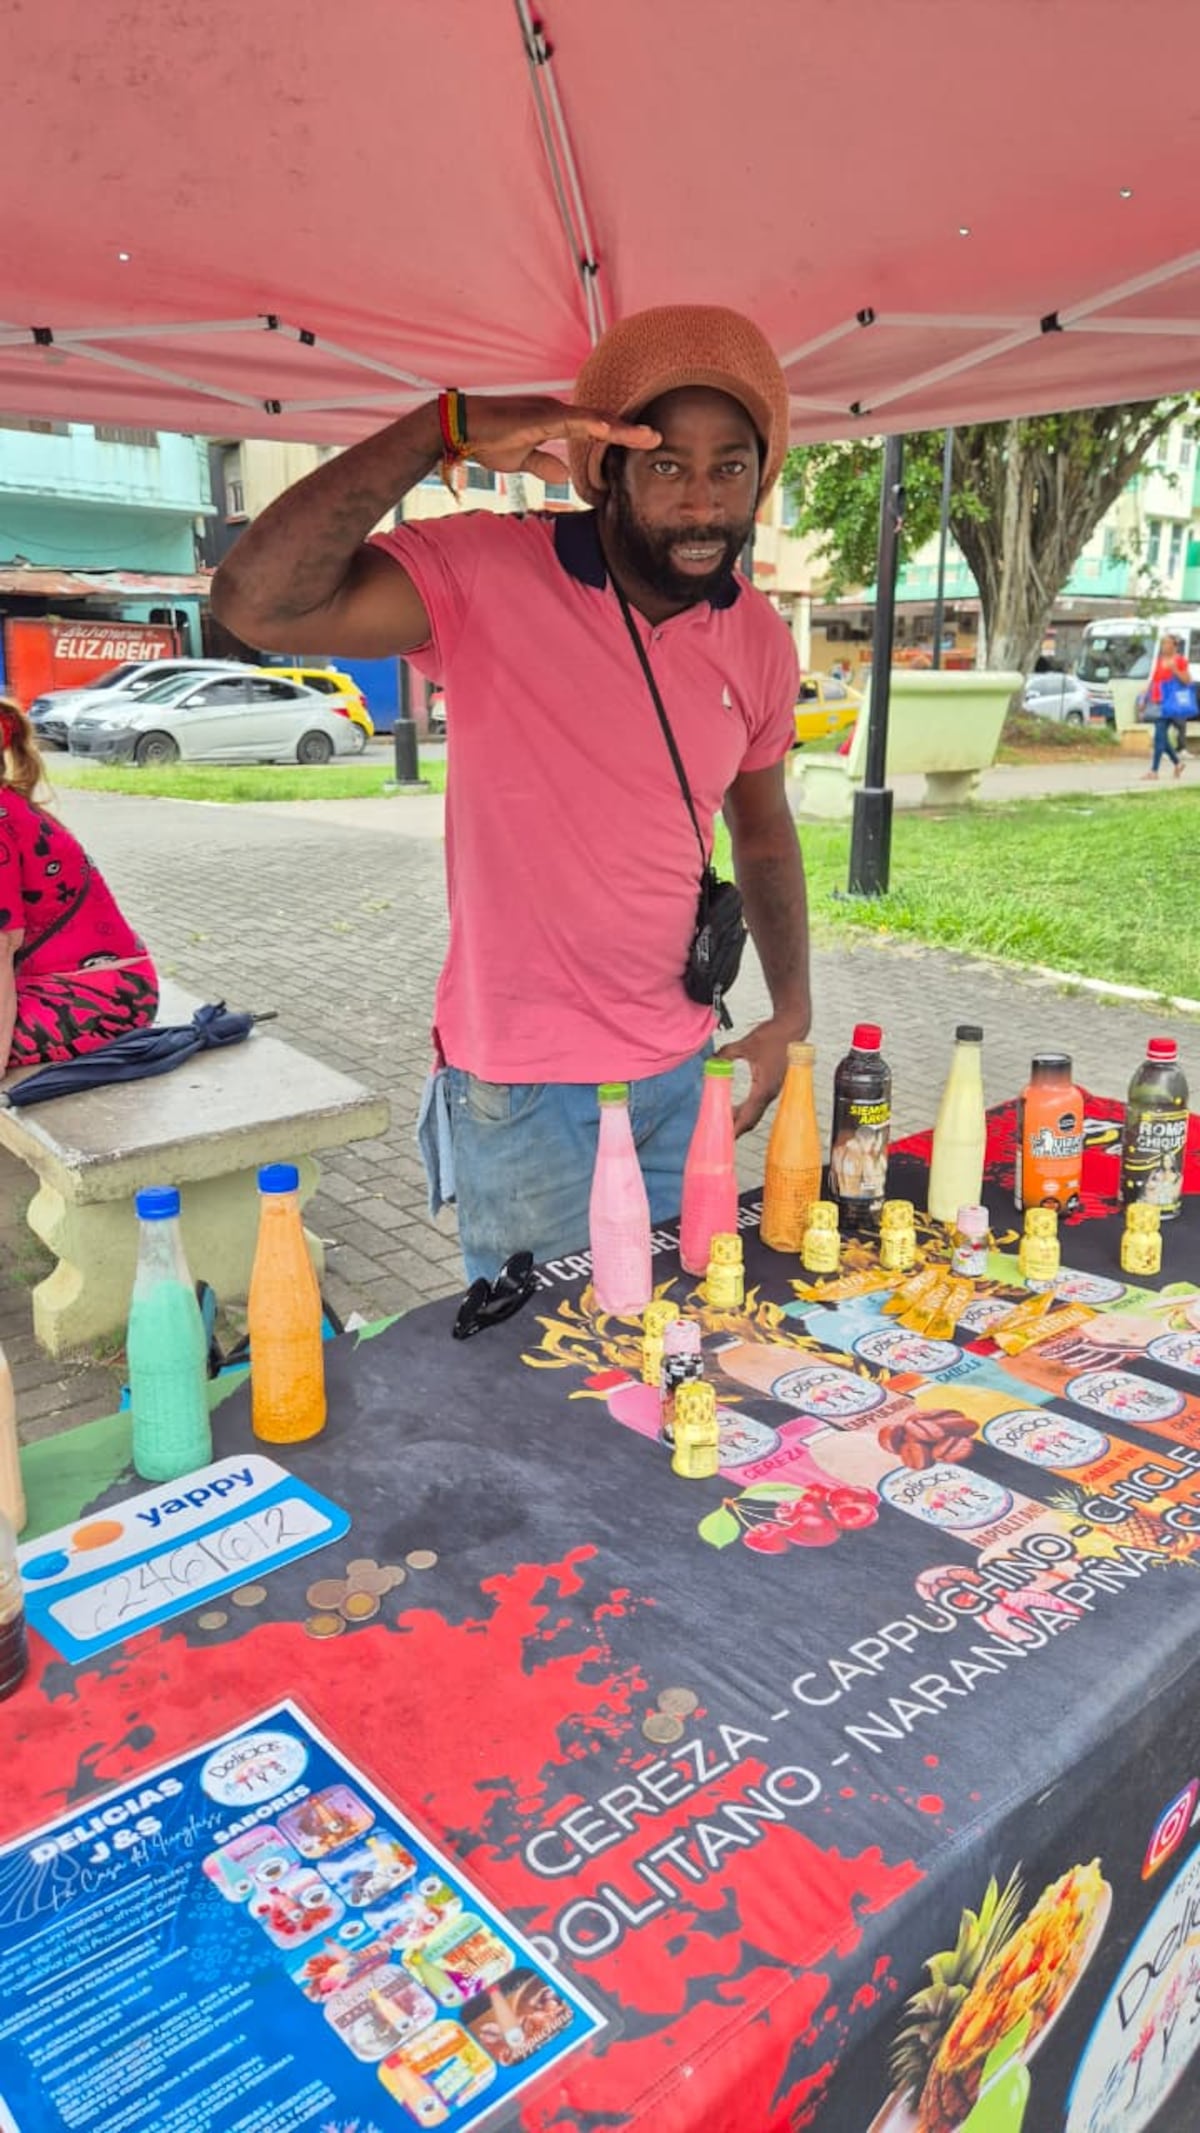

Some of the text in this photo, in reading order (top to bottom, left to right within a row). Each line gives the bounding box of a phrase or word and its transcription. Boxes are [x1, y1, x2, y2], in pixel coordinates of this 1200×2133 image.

[54, 638, 166, 660] ELIZABEHT
[742, 1444, 811, 1481] CEREZA
[135, 1467, 255, 1529] yappy
[524, 1722, 769, 1875] CEREZA
[792, 1534, 1072, 1707] CAPPUCHINO
[1083, 1446, 1200, 1523] CHICLE
[845, 1605, 1080, 1754] NARANJA
[1056, 1547, 1167, 1611] PIÑA
[29, 1777, 184, 1864] DELICIAS
[212, 1784, 311, 1845] SABORES
